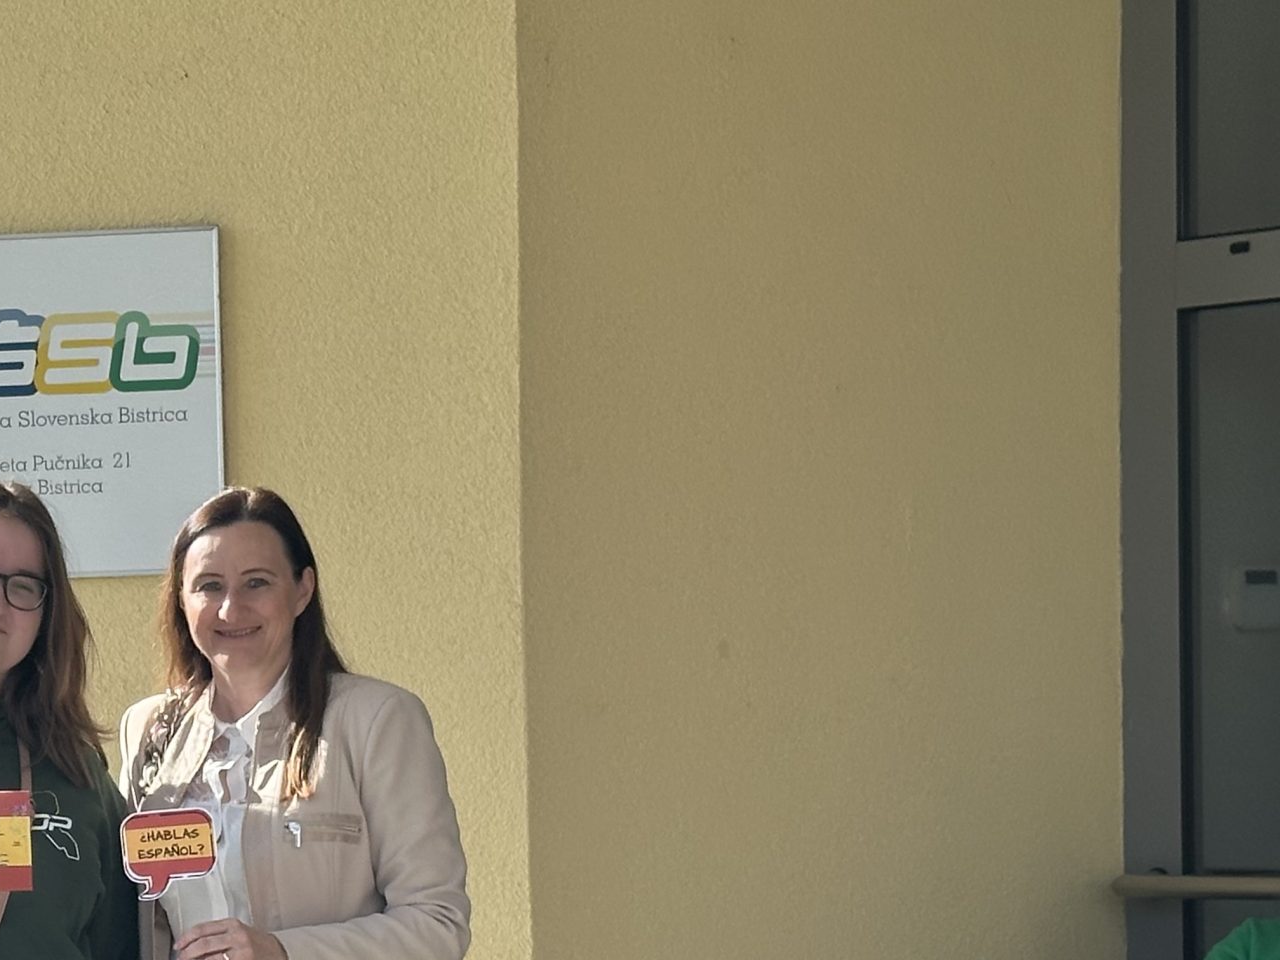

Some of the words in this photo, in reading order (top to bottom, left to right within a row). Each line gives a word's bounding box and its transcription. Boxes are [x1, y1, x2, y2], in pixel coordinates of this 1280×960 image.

[18, 407, 113, 428] Slovenska
[118, 406, 188, 424] Bistrica
[33, 454, 103, 471] Pučnika
[112, 452, 130, 469] 21
[38, 479, 103, 495] Bistrica
[140, 828, 200, 843] ¿HABLAS
[138, 843, 205, 860] ESPAÑOL?
